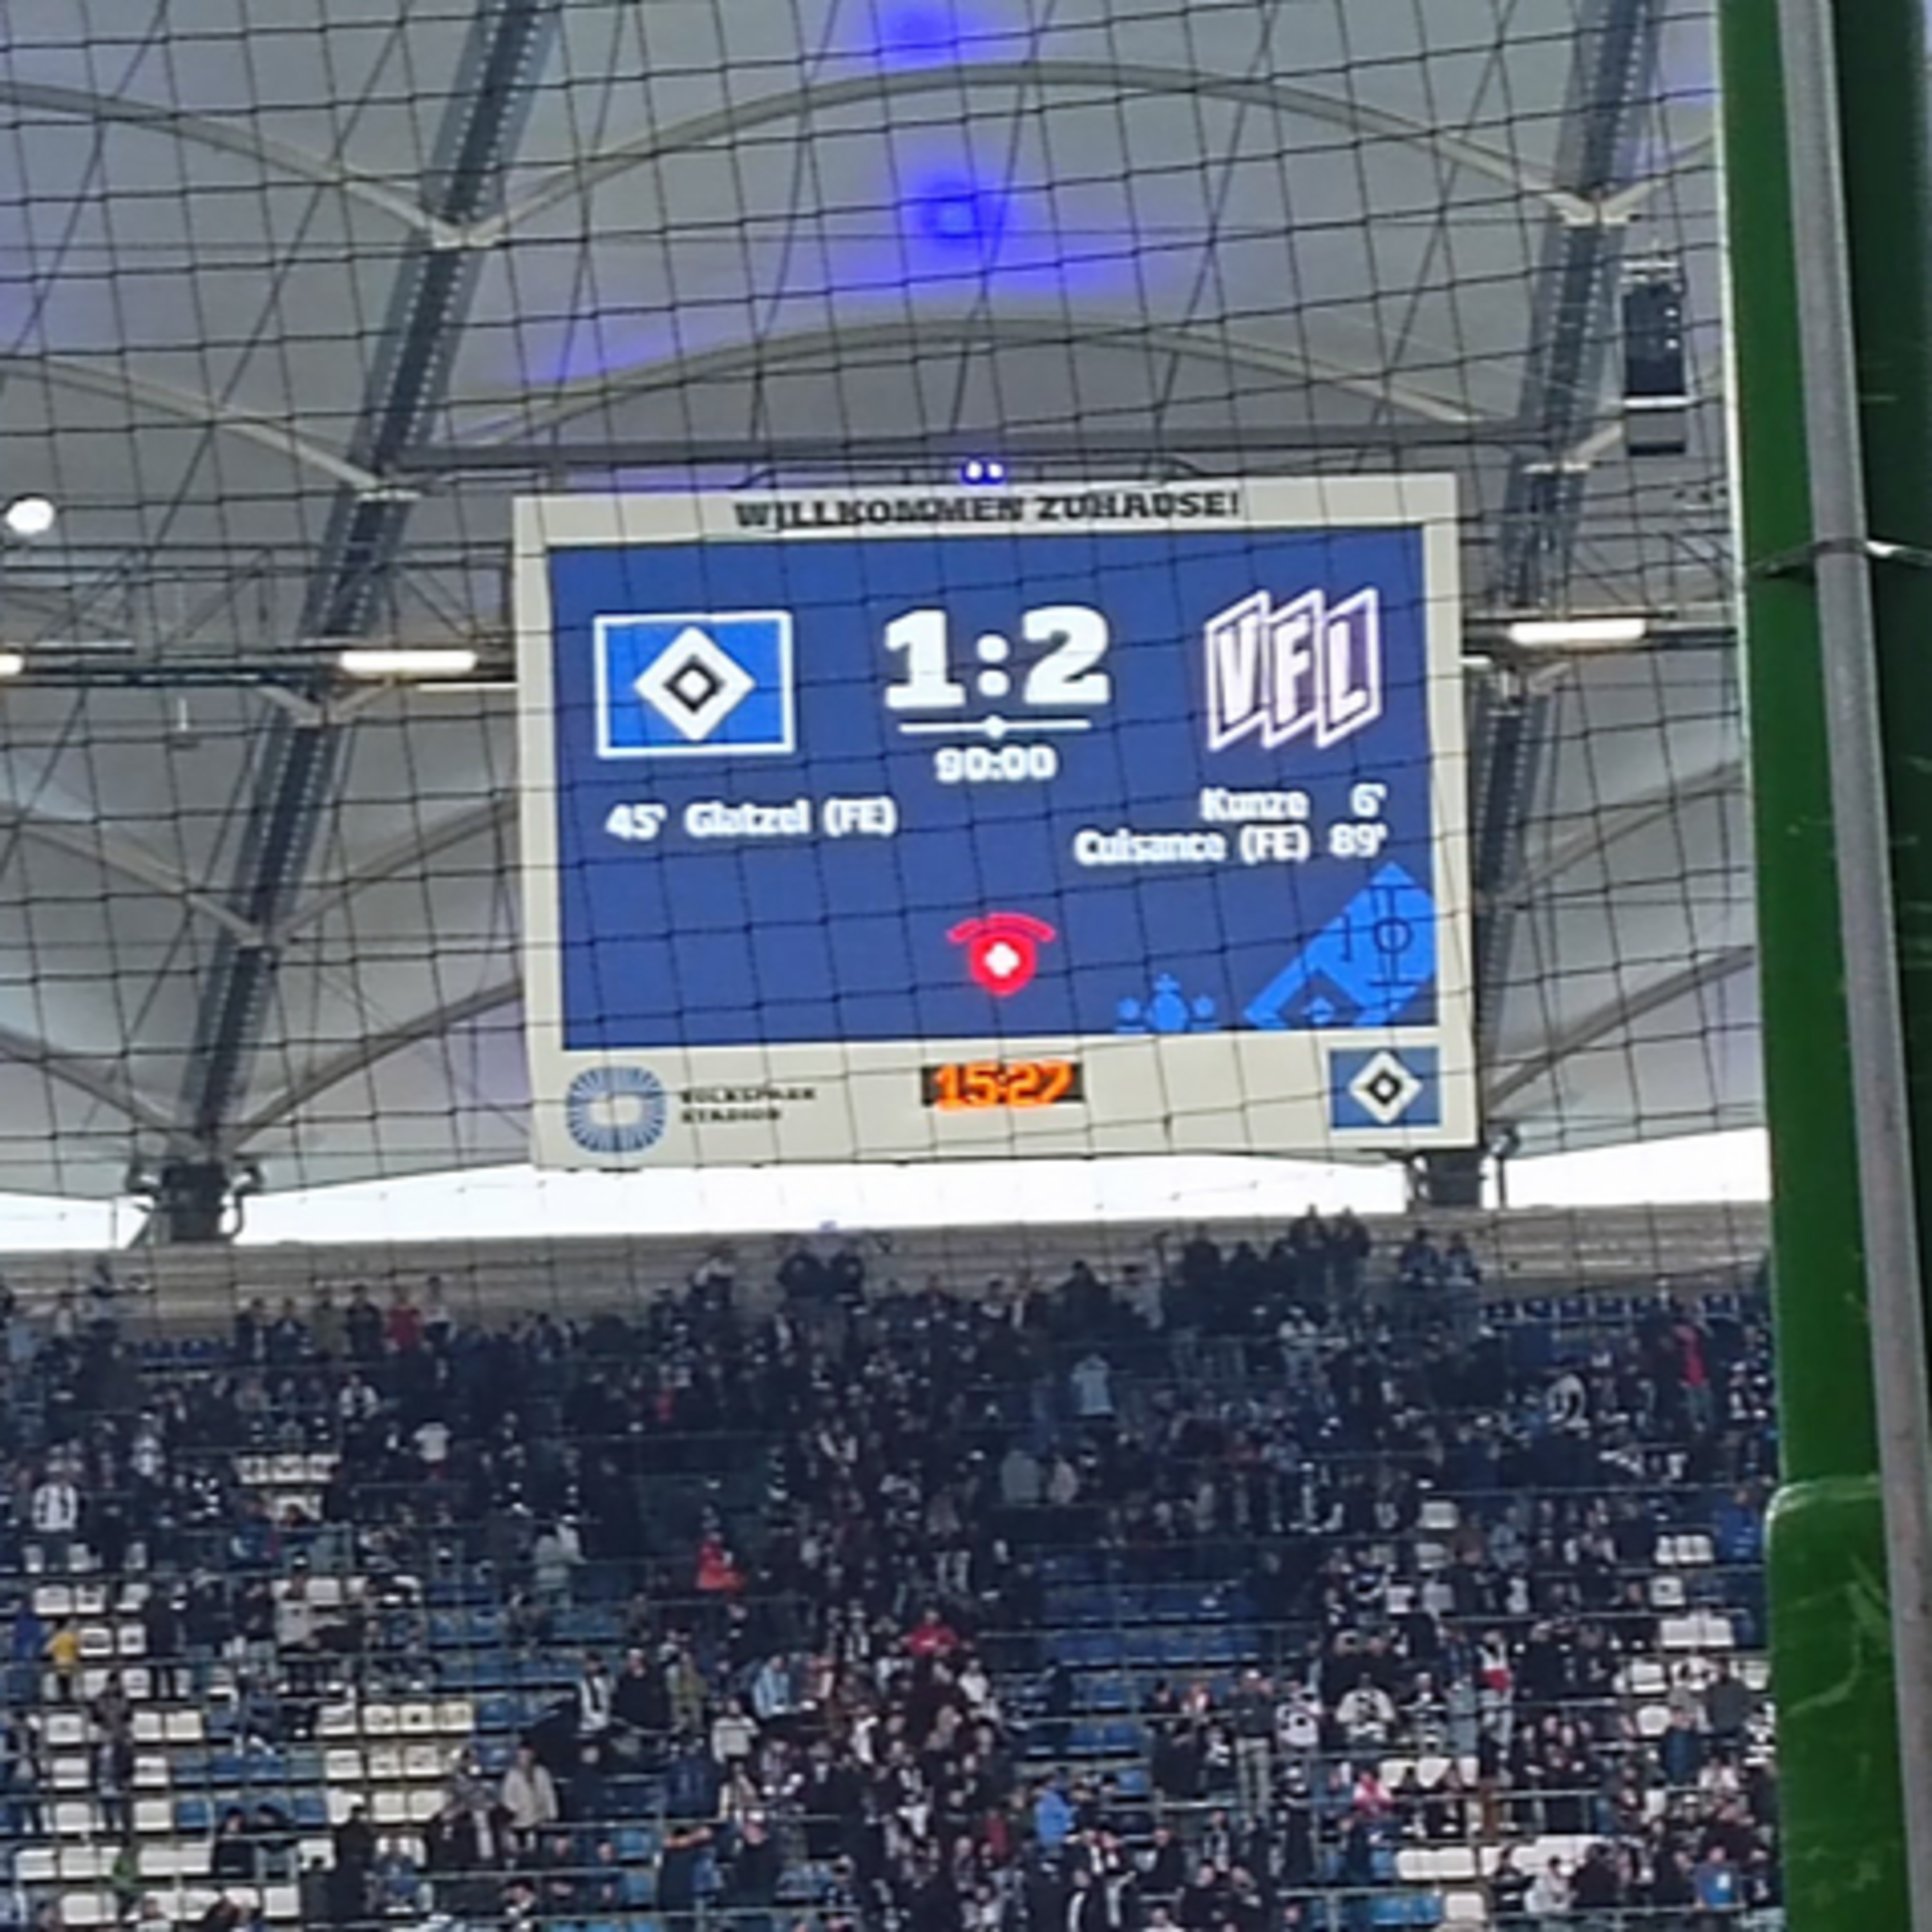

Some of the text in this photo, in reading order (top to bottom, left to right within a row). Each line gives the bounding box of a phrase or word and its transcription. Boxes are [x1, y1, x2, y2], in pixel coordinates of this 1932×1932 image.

[734, 491, 1240, 529] WILLKOMMEN ZUHAUSE!
[884, 605, 1111, 708] 1:2
[936, 745, 1056, 782] 90:00
[824, 797, 897, 837] (FE)
[1200, 788, 1309, 820] Kunze
[1240, 824, 1310, 864] (FE)
[933, 1059, 1074, 1109] 15:27
